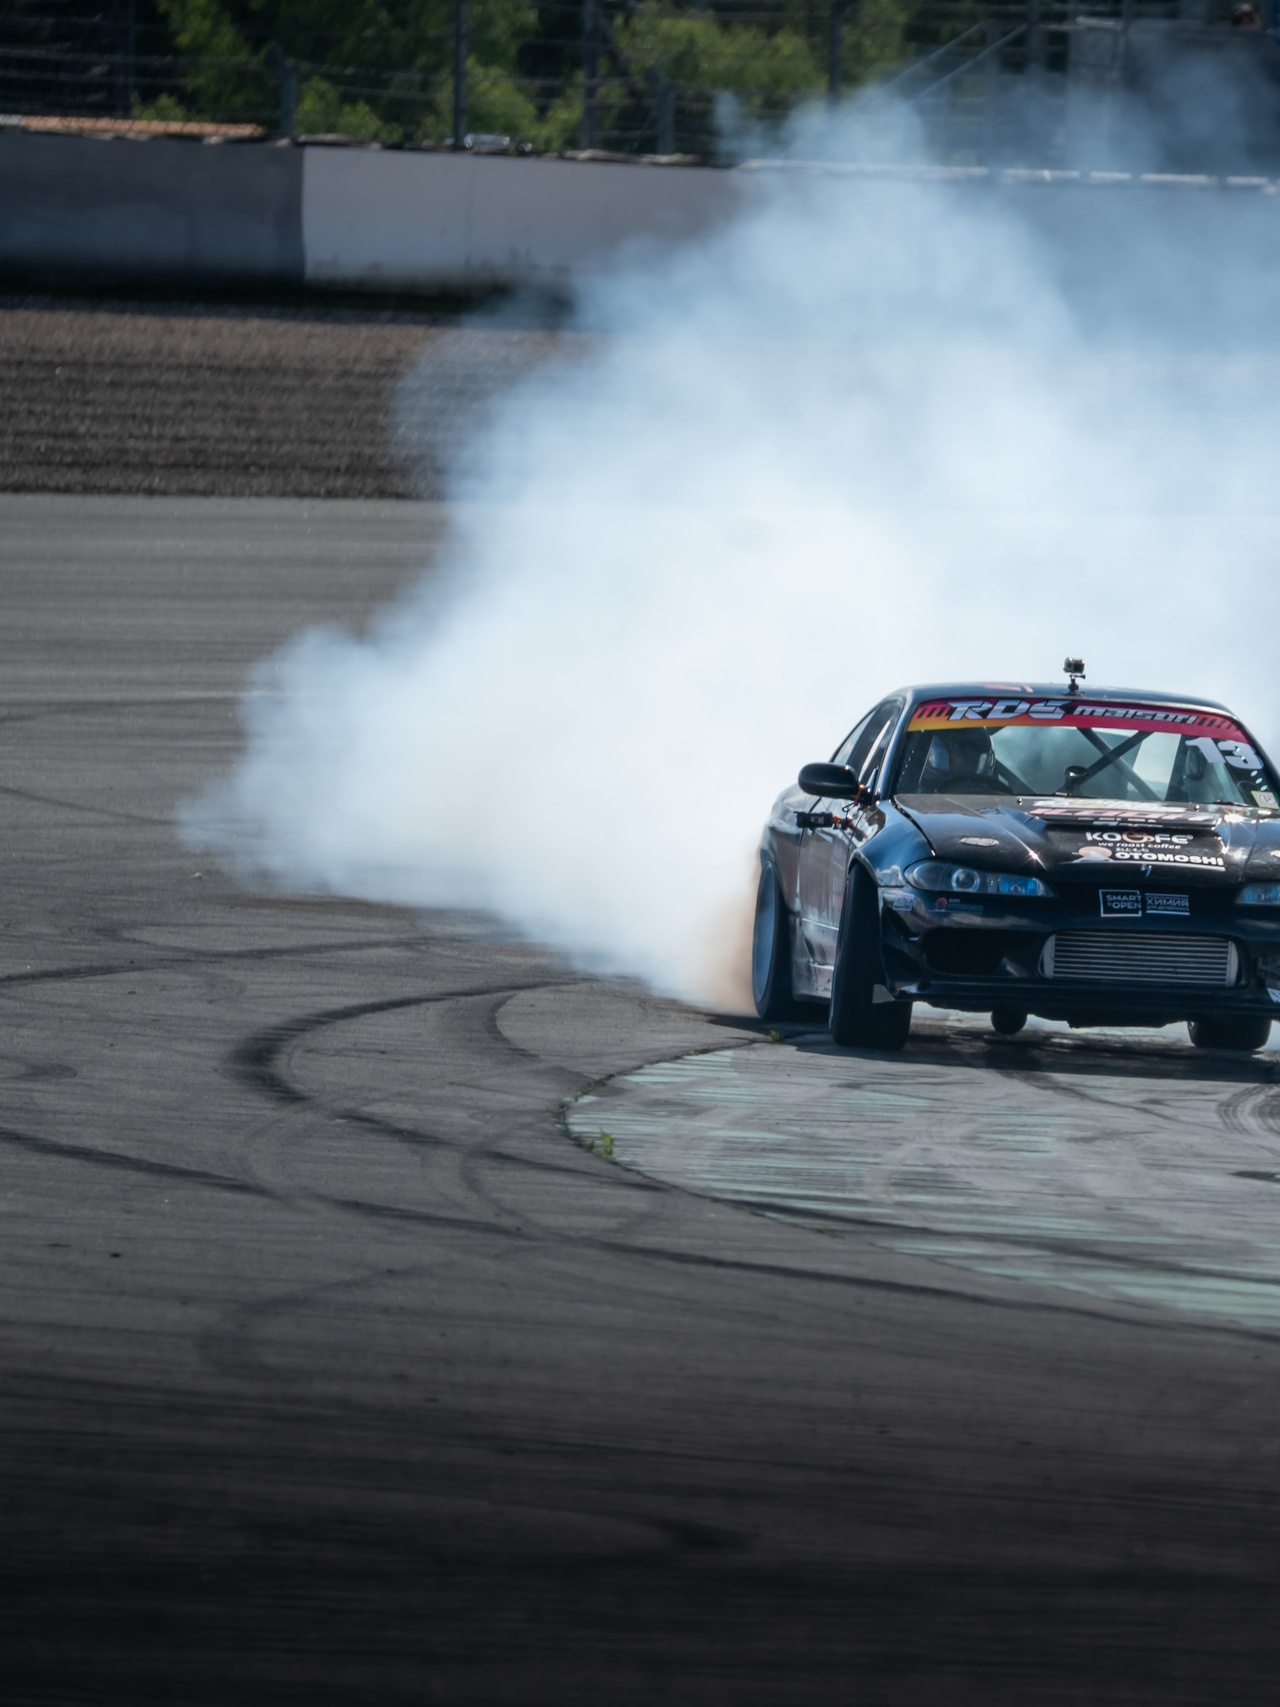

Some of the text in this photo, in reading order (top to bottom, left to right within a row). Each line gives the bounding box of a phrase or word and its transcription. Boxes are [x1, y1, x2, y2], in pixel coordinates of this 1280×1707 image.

[947, 700, 1072, 720] RDS
[1184, 736, 1264, 770] 13
[1115, 851, 1225, 866] OTOMOSHI
[1105, 894, 1142, 902] SMART
[1146, 898, 1189, 907] ХИМИЯ
[1112, 901, 1142, 910] OPEN
